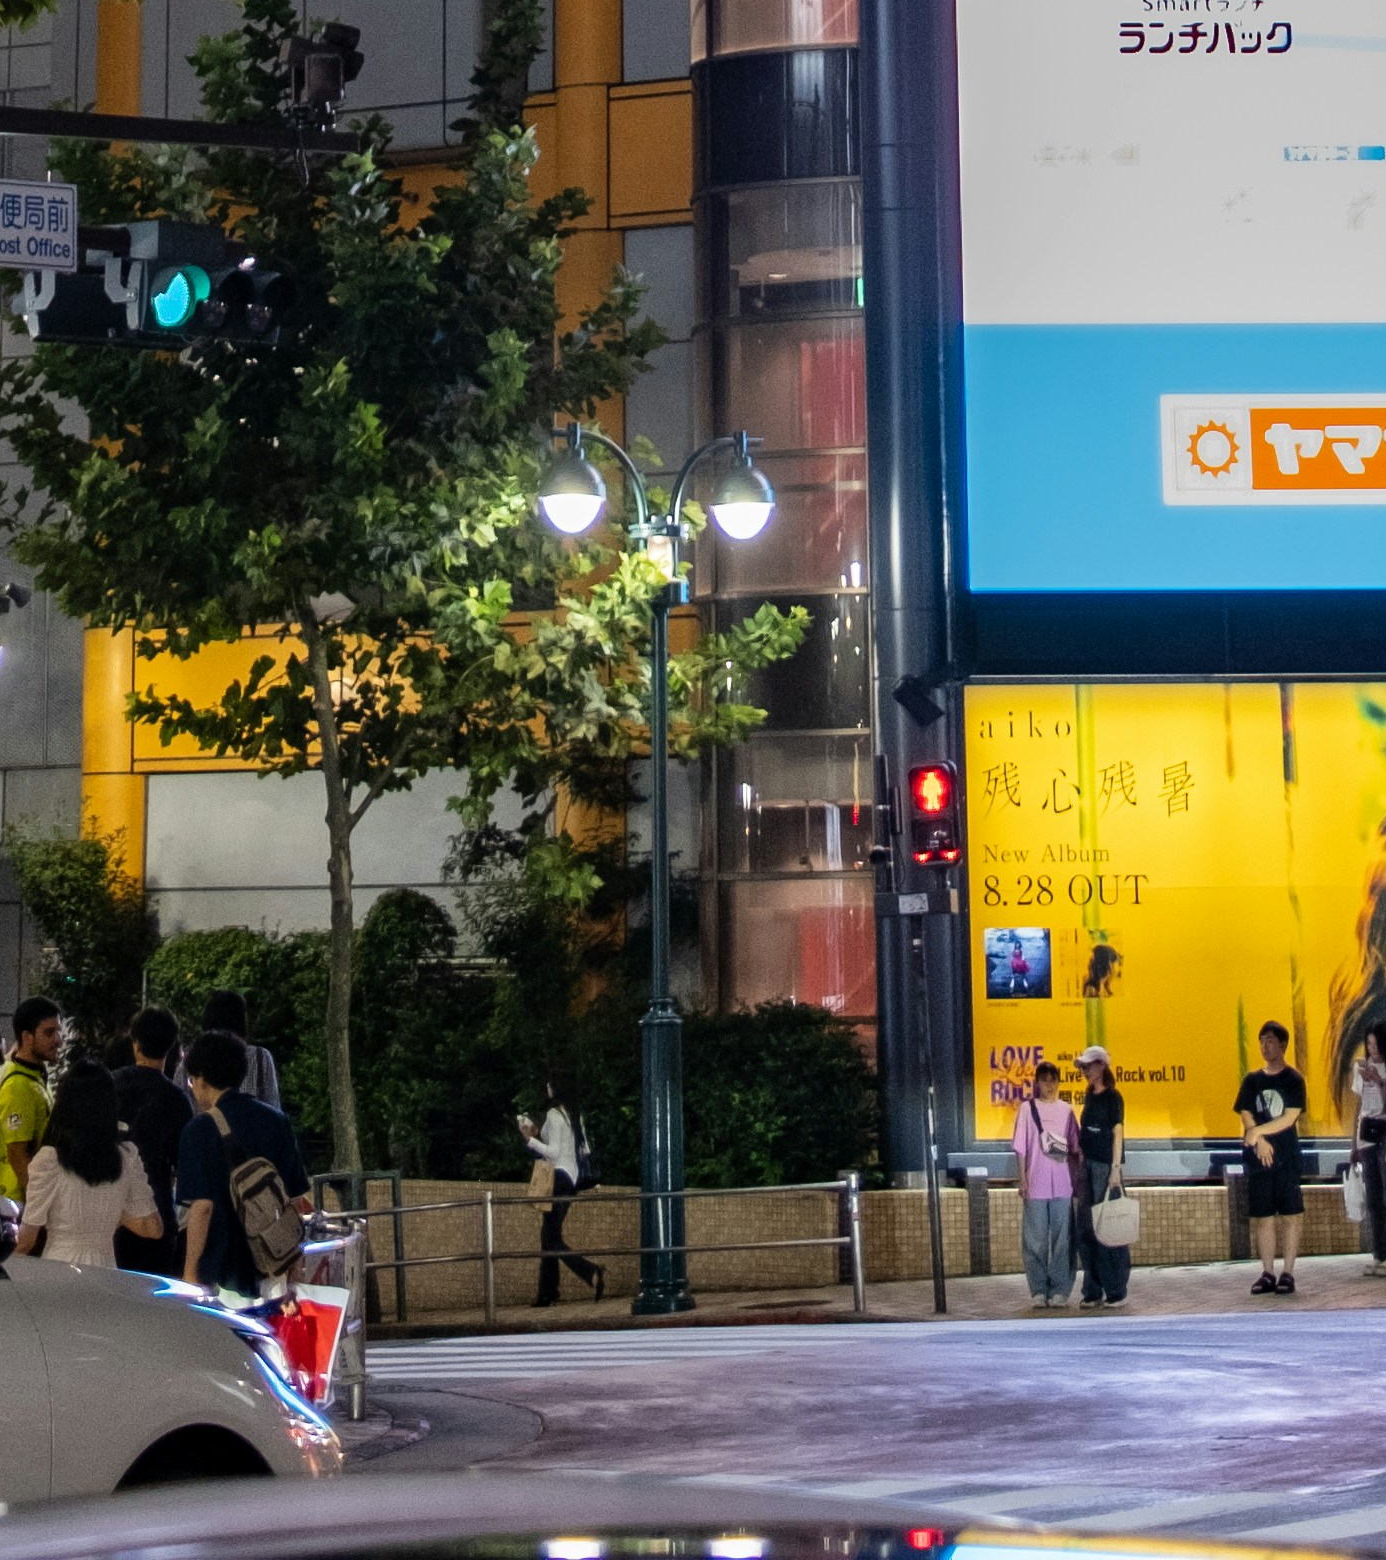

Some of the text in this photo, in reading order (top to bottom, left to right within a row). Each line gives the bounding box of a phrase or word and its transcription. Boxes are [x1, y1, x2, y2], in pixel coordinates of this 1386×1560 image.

[1119, 22, 1293, 53] ランチパック
[26, 236, 70, 258] Office
[980, 711, 1071, 739] aiko
[982, 760, 1195, 819] 残心残暑
[983, 844, 1110, 863] New Album
[984, 874, 1149, 906] 8.28 OUT
[990, 1045, 1044, 1069] LOVE
[1116, 1066, 1145, 1082] Rock
